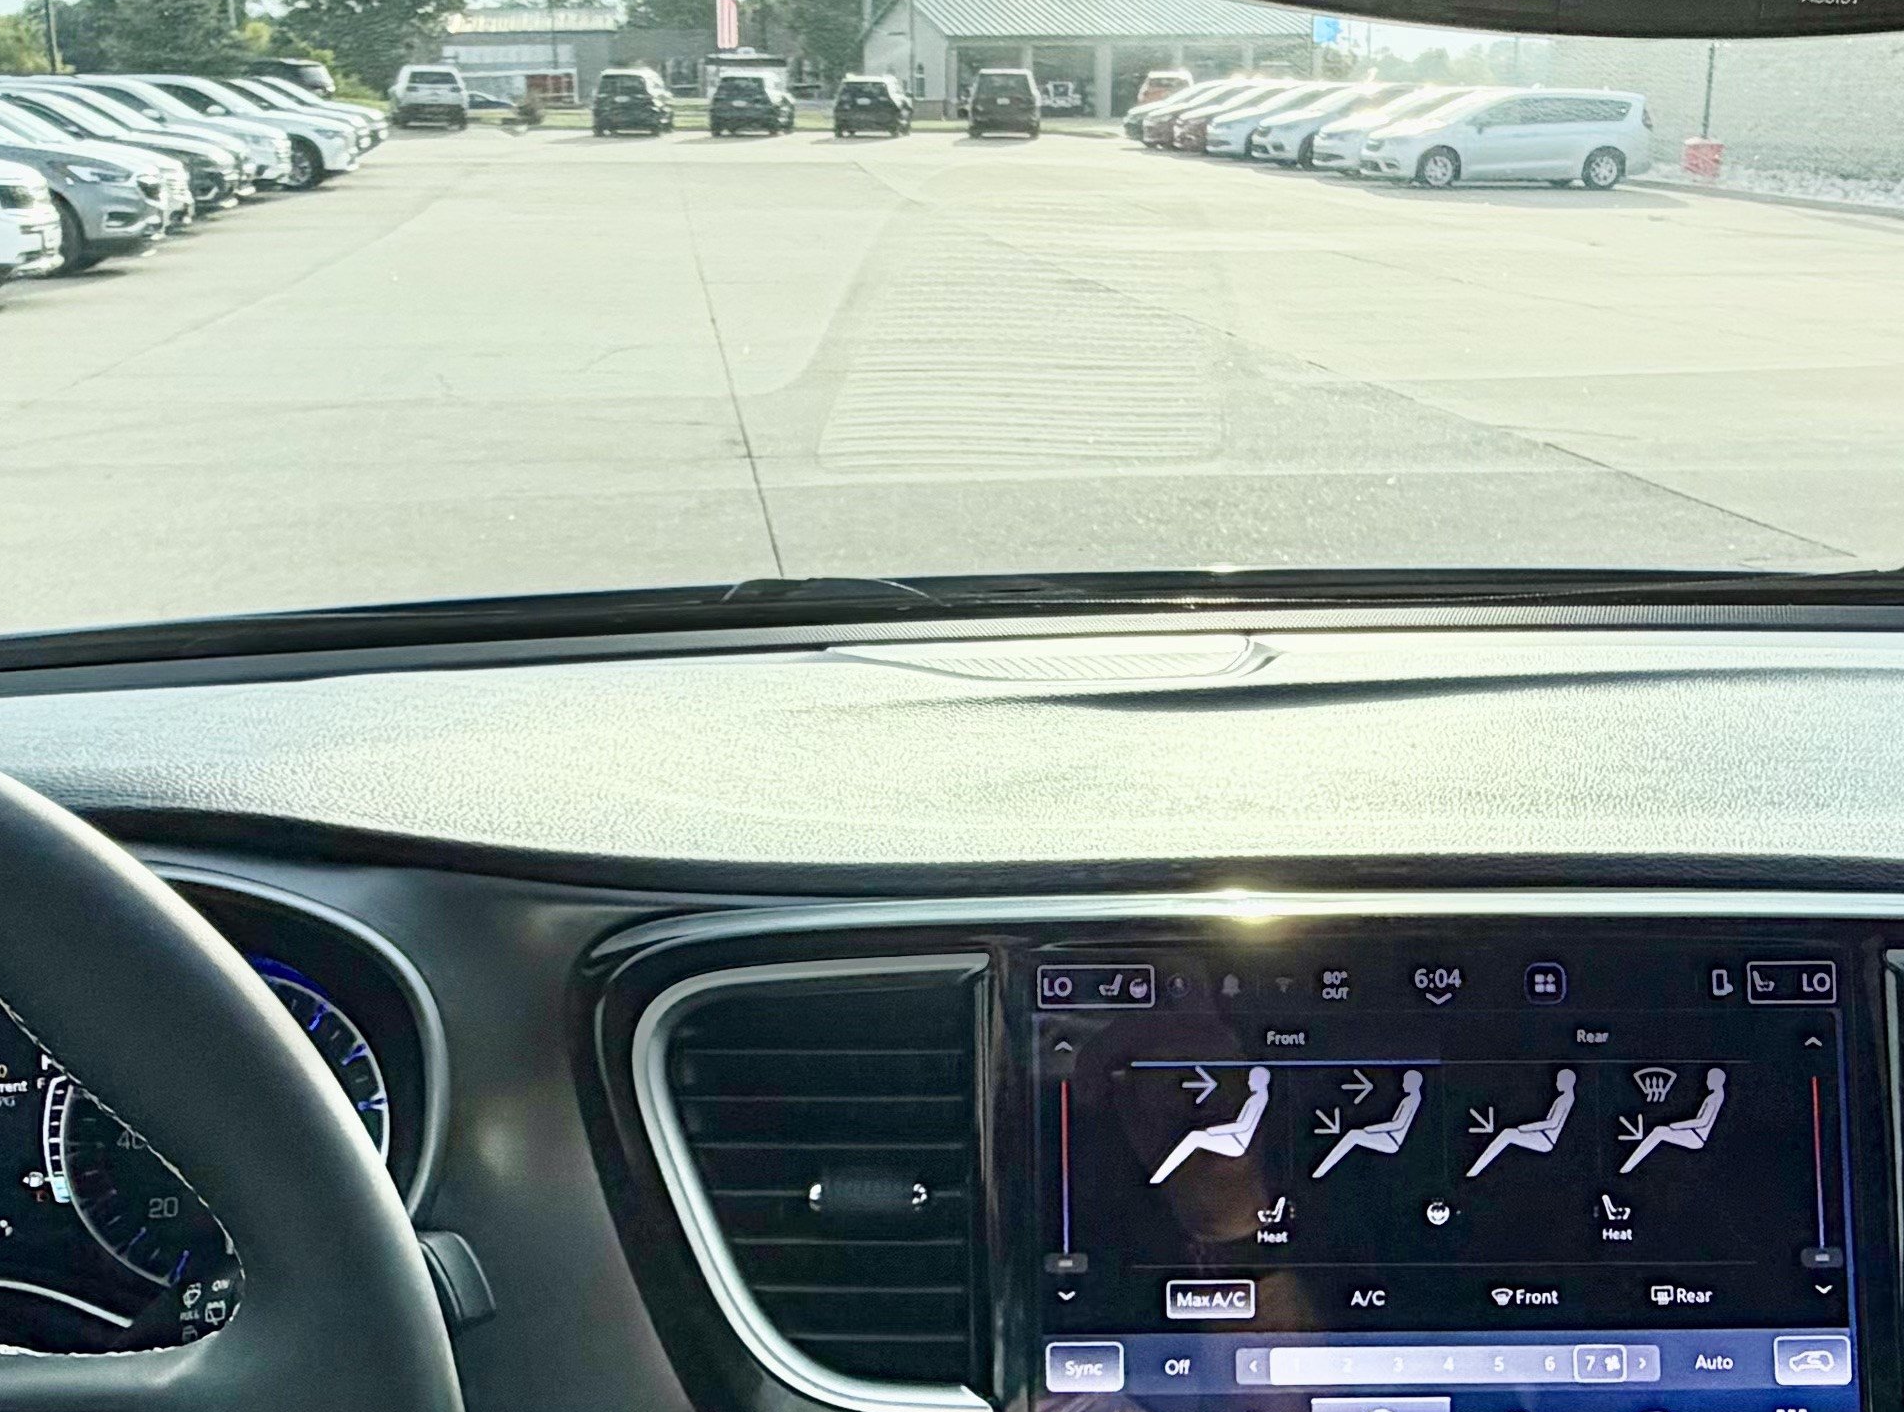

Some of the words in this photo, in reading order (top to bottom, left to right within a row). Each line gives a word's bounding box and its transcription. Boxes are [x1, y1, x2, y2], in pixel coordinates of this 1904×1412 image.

[1042, 976, 1072, 998] LO
[1414, 968, 1462, 989] 6:04
[1802, 973, 1830, 992] LO
[1321, 986, 1349, 1000] OUT
[1266, 1030, 1306, 1046] Front
[1576, 1029, 1609, 1044] Rear
[147, 1195, 181, 1221] 20
[1257, 1230, 1288, 1243] Heat
[1602, 1228, 1633, 1241] Heat
[1176, 1291, 1210, 1308] Max
[1212, 1290, 1247, 1308] A/C
[1350, 1290, 1386, 1307] A/C
[1515, 1288, 1559, 1305] Front
[1676, 1287, 1713, 1304] Rear
[1063, 1359, 1104, 1377] Sync
[1164, 1358, 1191, 1376] Off
[1543, 1357, 1556, 1372] 6
[1584, 1357, 1596, 1371] 7
[1694, 1354, 1734, 1370] Auto
